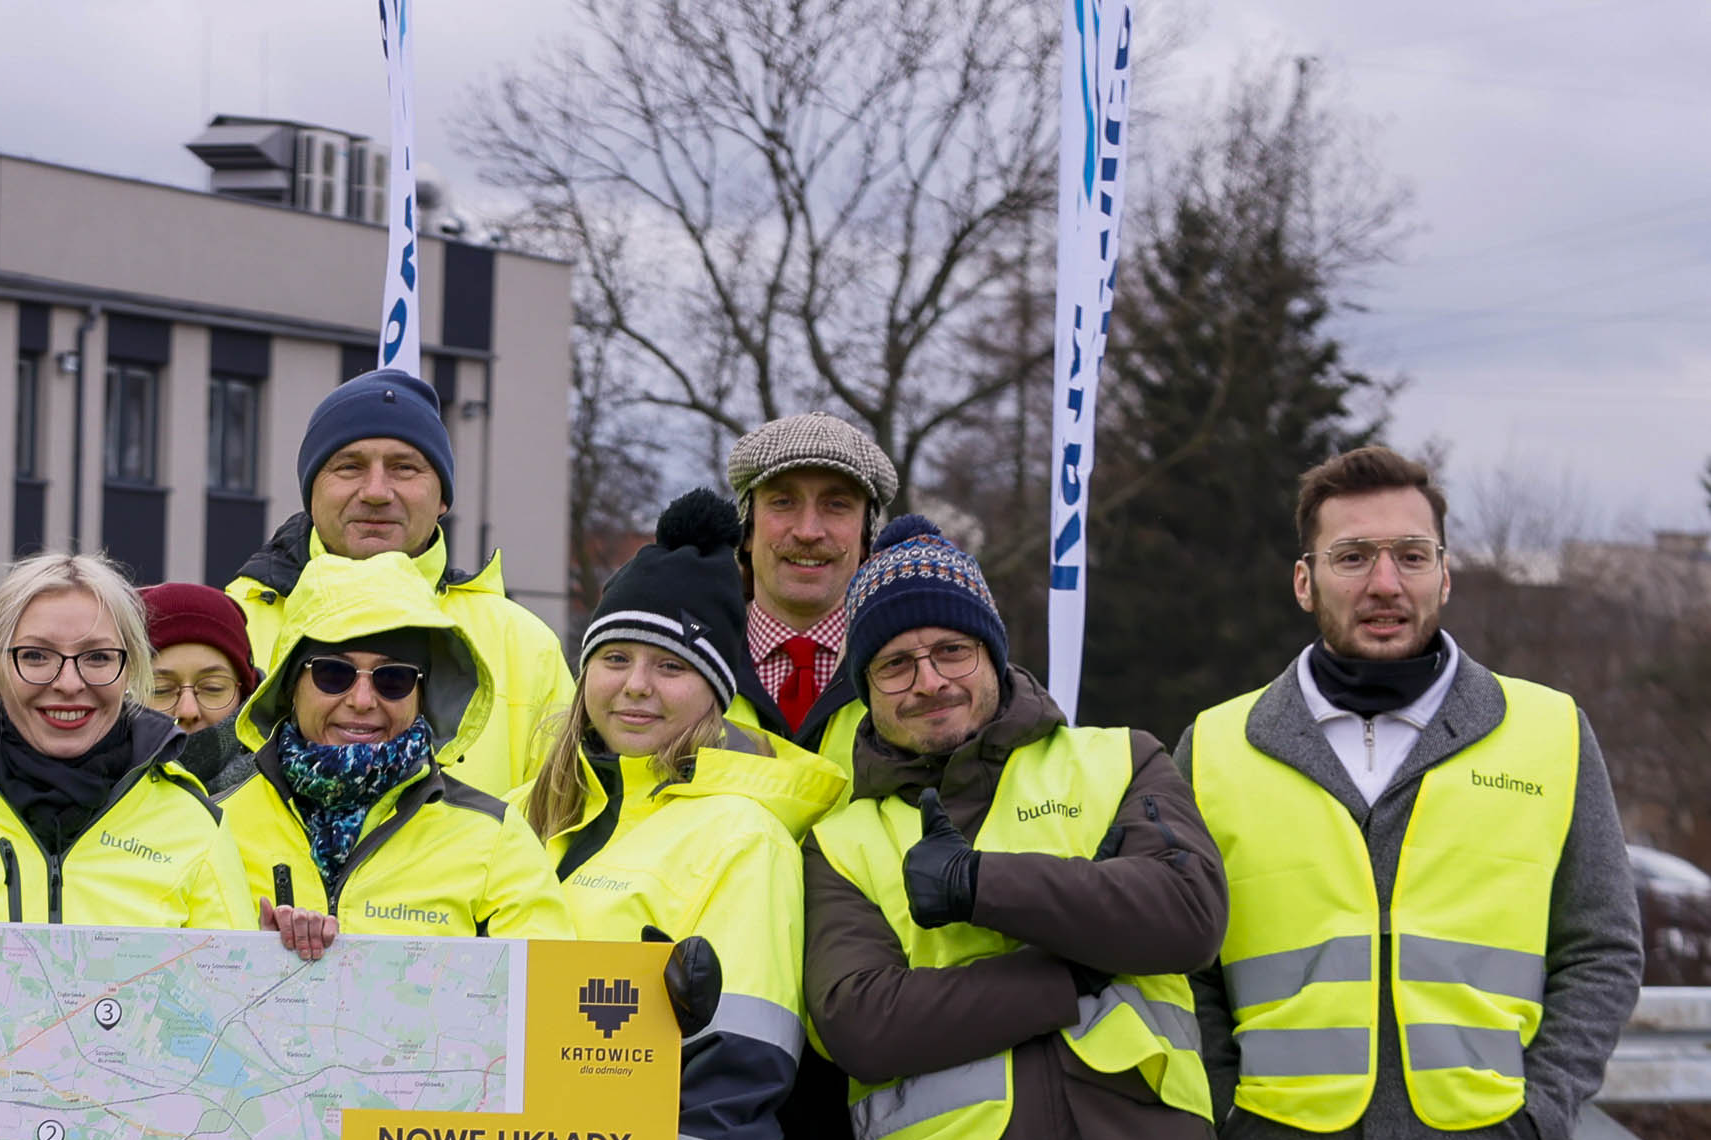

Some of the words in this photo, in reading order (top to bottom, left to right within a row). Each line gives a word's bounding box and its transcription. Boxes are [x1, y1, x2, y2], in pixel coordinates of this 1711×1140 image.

[1471, 768, 1544, 797] budimex
[1016, 799, 1082, 822] budime
[100, 829, 173, 865] budimex
[364, 900, 450, 925] budimex
[102, 1004, 114, 1021] 3
[561, 1047, 654, 1063] KATOWICE
[579, 1065, 595, 1075] dla
[595, 1065, 634, 1078] odmiany
